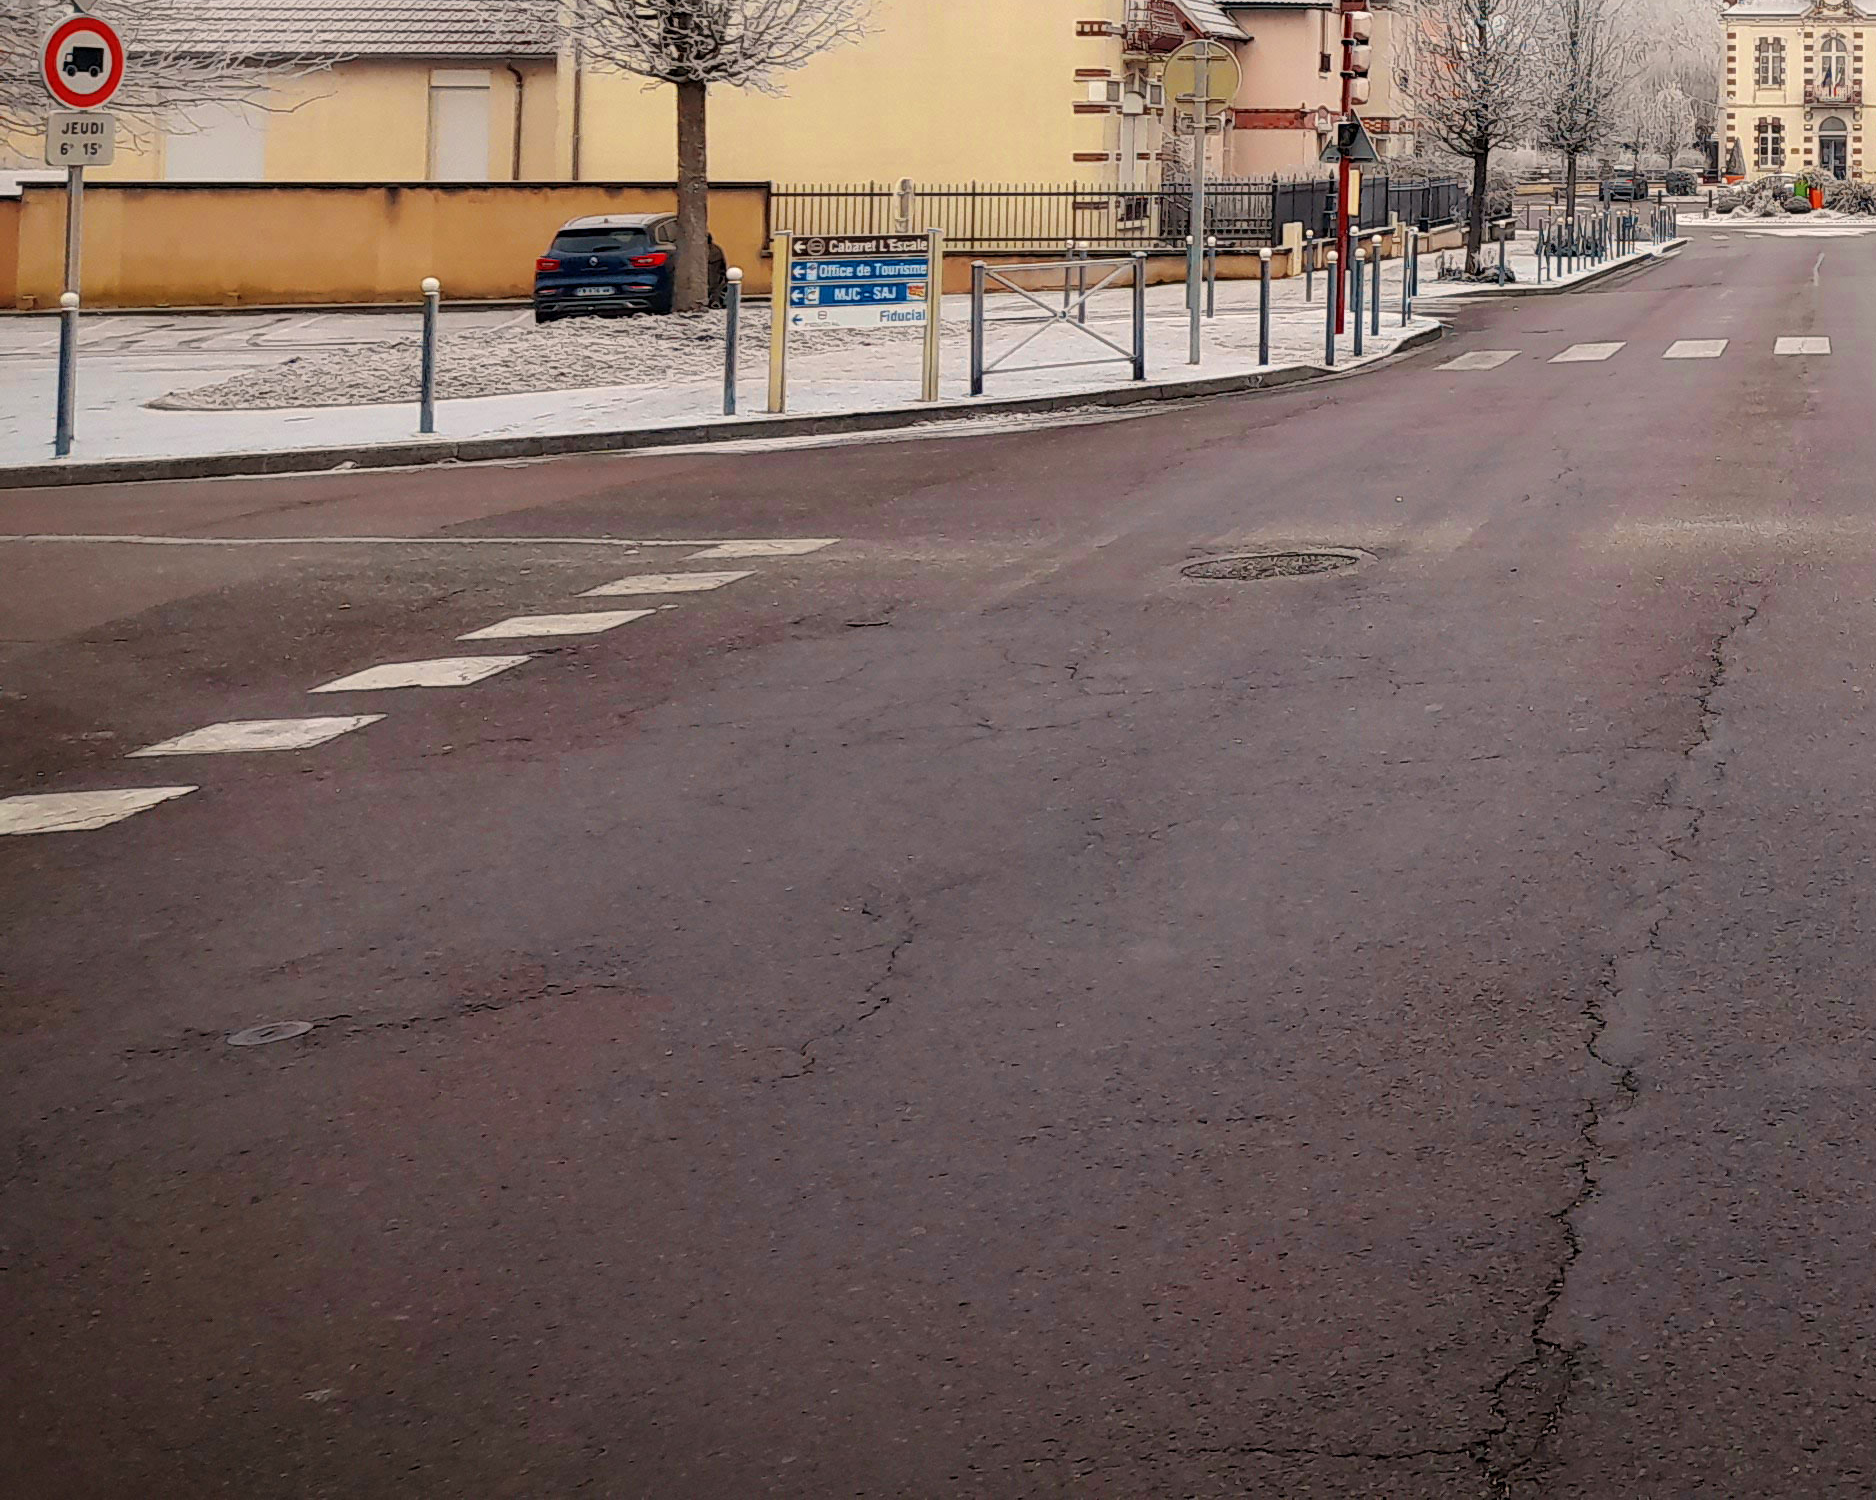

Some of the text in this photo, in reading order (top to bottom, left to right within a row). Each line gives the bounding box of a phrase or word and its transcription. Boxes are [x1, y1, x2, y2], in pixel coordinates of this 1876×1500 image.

[61, 122, 104, 135] JEUDI
[829, 238, 928, 253] Cabaret L'Escale
[819, 262, 927, 277] Office de Tourisme
[834, 287, 861, 301] MJC
[873, 286, 897, 299] SAJ
[880, 308, 926, 323] Fiducial
